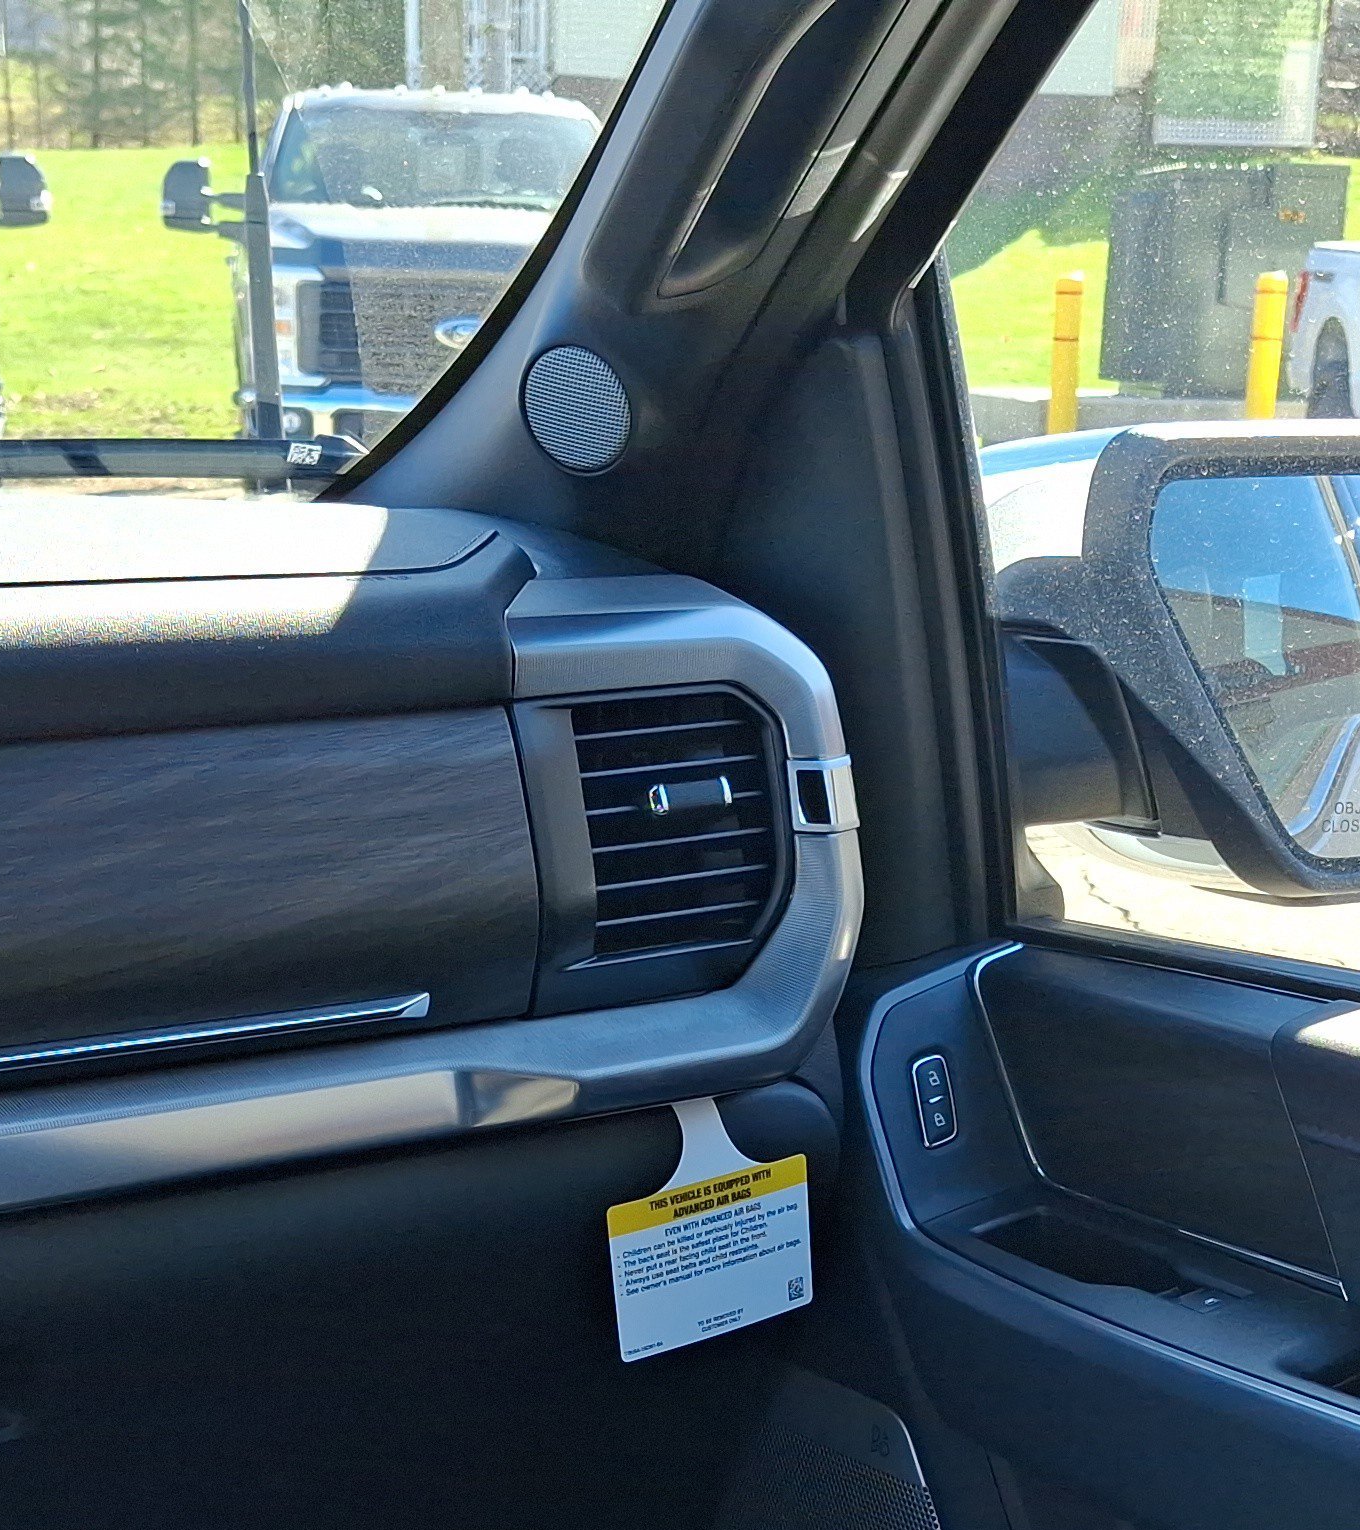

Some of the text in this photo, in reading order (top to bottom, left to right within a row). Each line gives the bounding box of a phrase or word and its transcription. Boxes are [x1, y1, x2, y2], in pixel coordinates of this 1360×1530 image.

[650, 1168, 771, 1211] THIS VEHICLE IS EQUIPPED WITH
[673, 1188, 752, 1218] ADVANCED AIR BAGS
[683, 1220, 699, 1231] WITH
[701, 1211, 733, 1226] ADVANCED
[734, 1207, 745, 1217] AIR
[746, 1202, 761, 1213] BAGS
[623, 1247, 652, 1259] Children
[654, 1243, 666, 1251] can
[667, 1240, 676, 1248] be
[767, 1210, 776, 1218] the
[624, 1260, 636, 1268] The
[638, 1255, 654, 1265] back
[625, 1267, 644, 1277] Never
[646, 1263, 657, 1273] put
[701, 1247, 717, 1256] child
[626, 1276, 650, 1287] Always
[652, 1272, 664, 1280] use
[712, 1253, 728, 1262] child
[626, 1288, 639, 1296] See
[705, 1265, 721, 1274] more
